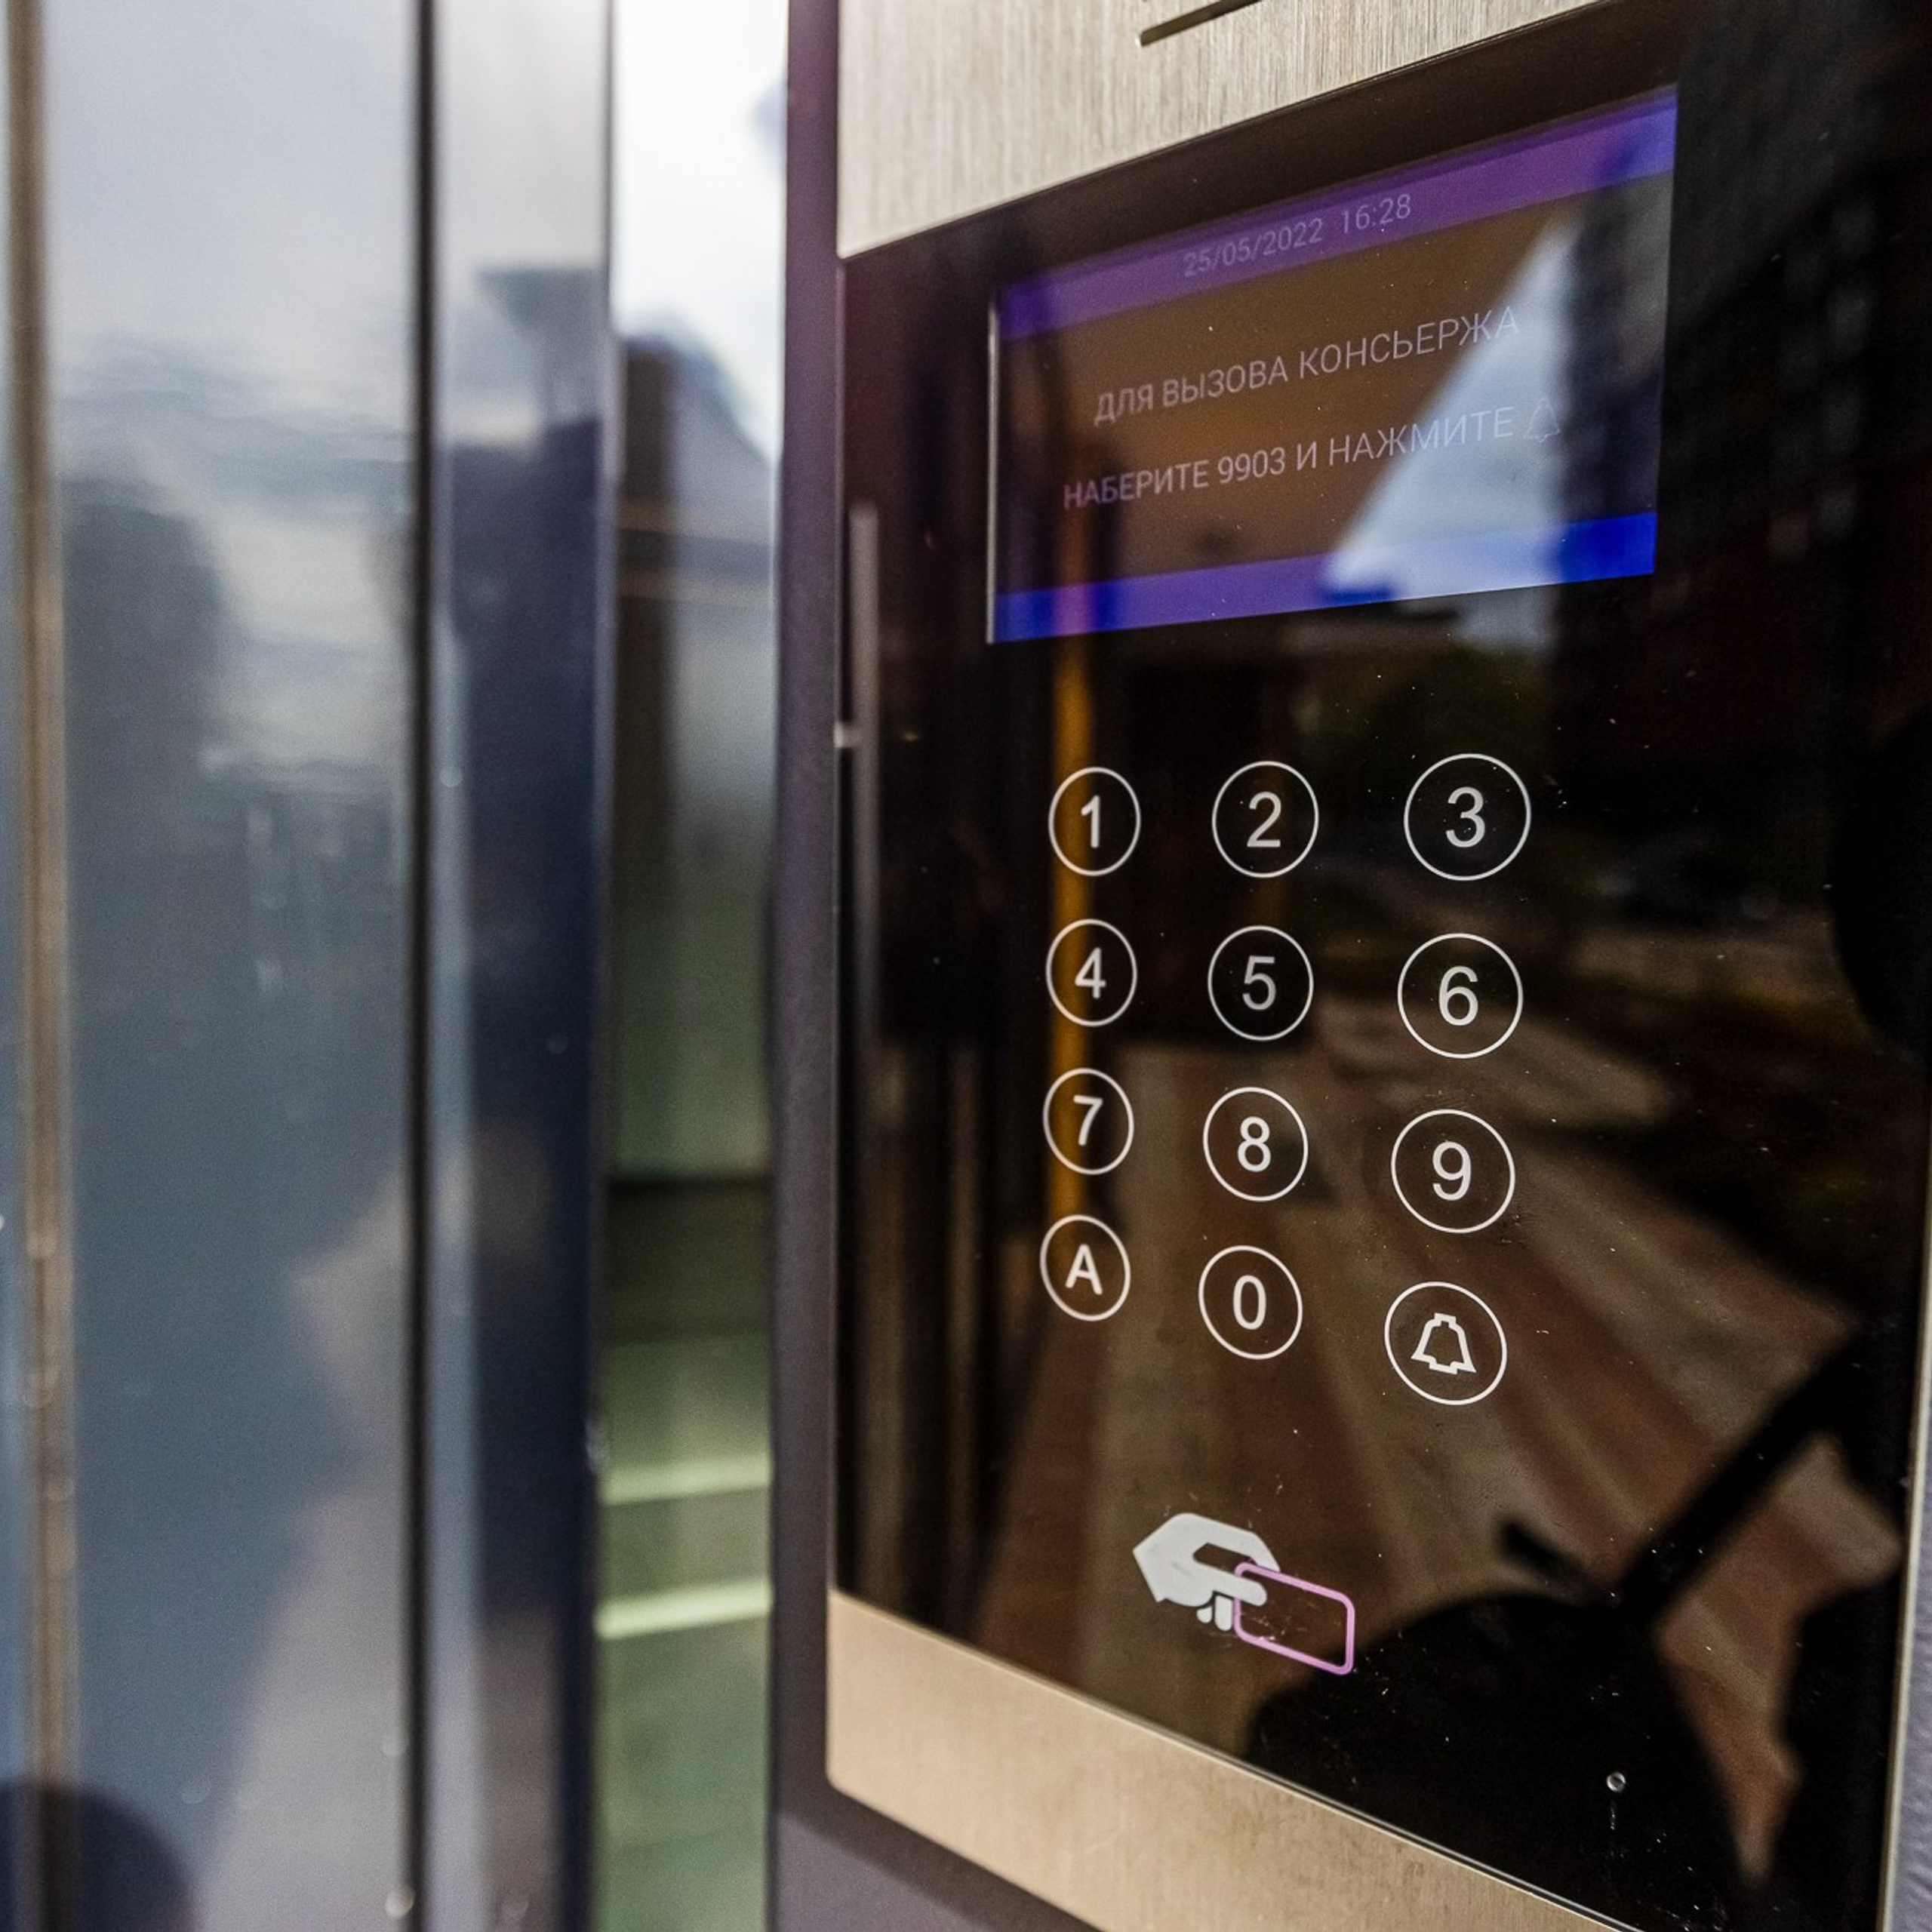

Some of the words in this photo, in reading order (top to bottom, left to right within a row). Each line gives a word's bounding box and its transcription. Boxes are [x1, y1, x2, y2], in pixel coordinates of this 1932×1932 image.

[1183, 218, 1322, 278] 25/05/2022
[1341, 193, 1411, 235] 16:28
[1094, 383, 1154, 426] ДЛЯ
[1162, 355, 1288, 409] ВЫЗОВА
[1300, 305, 1520, 379] КОНСЬЕРЖА
[1063, 460, 1209, 510] НАБЕРИТЕ
[1217, 447, 1286, 484] 9903
[1297, 441, 1317, 471] И
[1329, 406, 1514, 466] НАЖМИТЕ
[1081, 795, 1101, 848] 1
[1247, 792, 1281, 848] 2
[1445, 786, 1485, 848] 3
[1075, 948, 1106, 999] 4
[1241, 955, 1276, 1011] 5
[1438, 966, 1478, 1026] 6
[1073, 1095, 1103, 1146] 7
[1237, 1116, 1272, 1172] 8
[1432, 1141, 1472, 1201] 9
[1232, 1274, 1266, 1330] 0
